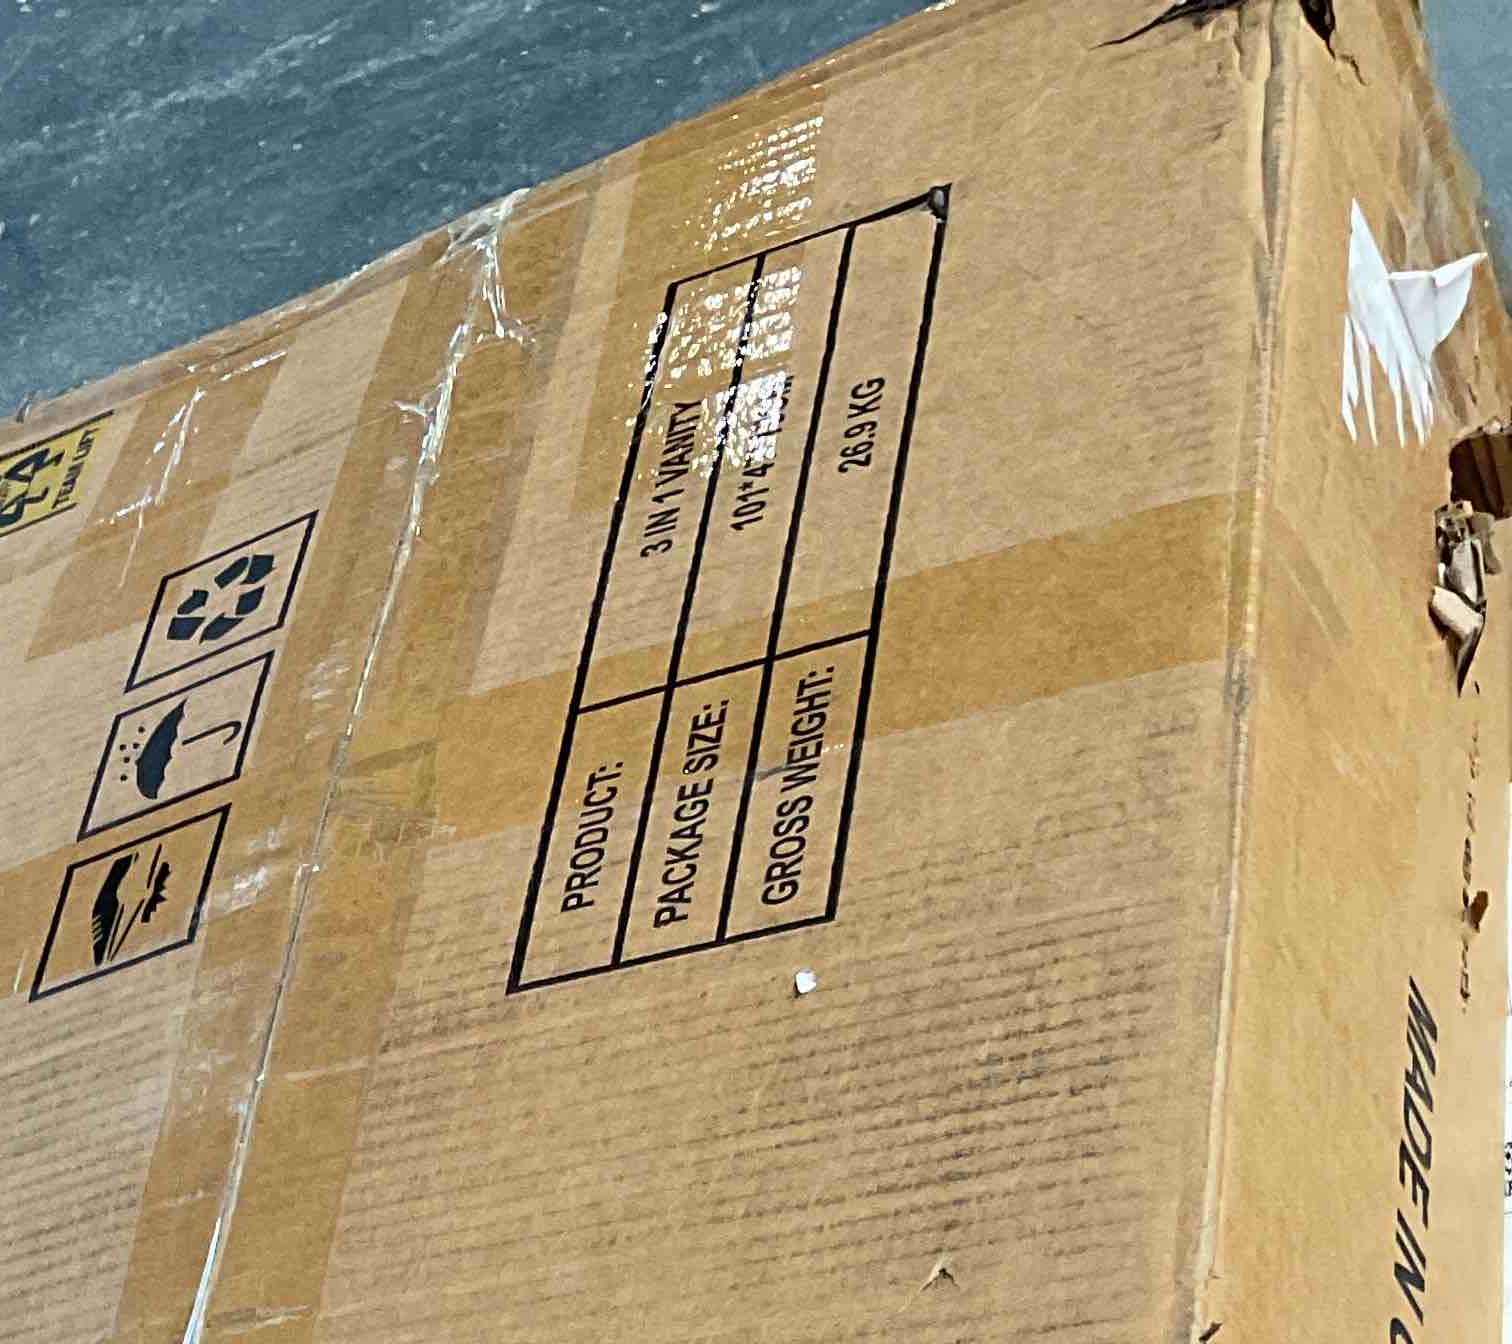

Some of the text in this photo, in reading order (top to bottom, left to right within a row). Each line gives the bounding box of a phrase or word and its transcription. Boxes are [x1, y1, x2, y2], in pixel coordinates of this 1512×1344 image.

[51, 428, 100, 510] TEAM LIFT
[640, 400, 701, 558] 3 IN 1 VANITY
[838, 377, 885, 473] 26.9 KG
[560, 762, 624, 913] PRODUCT:
[653, 699, 729, 928] PACKAGE SIZE:
[761, 666, 835, 905] GROSS WEIGHT:
[1399, 975, 1438, 1228] MADE
[1394, 1208, 1426, 1326] IN
